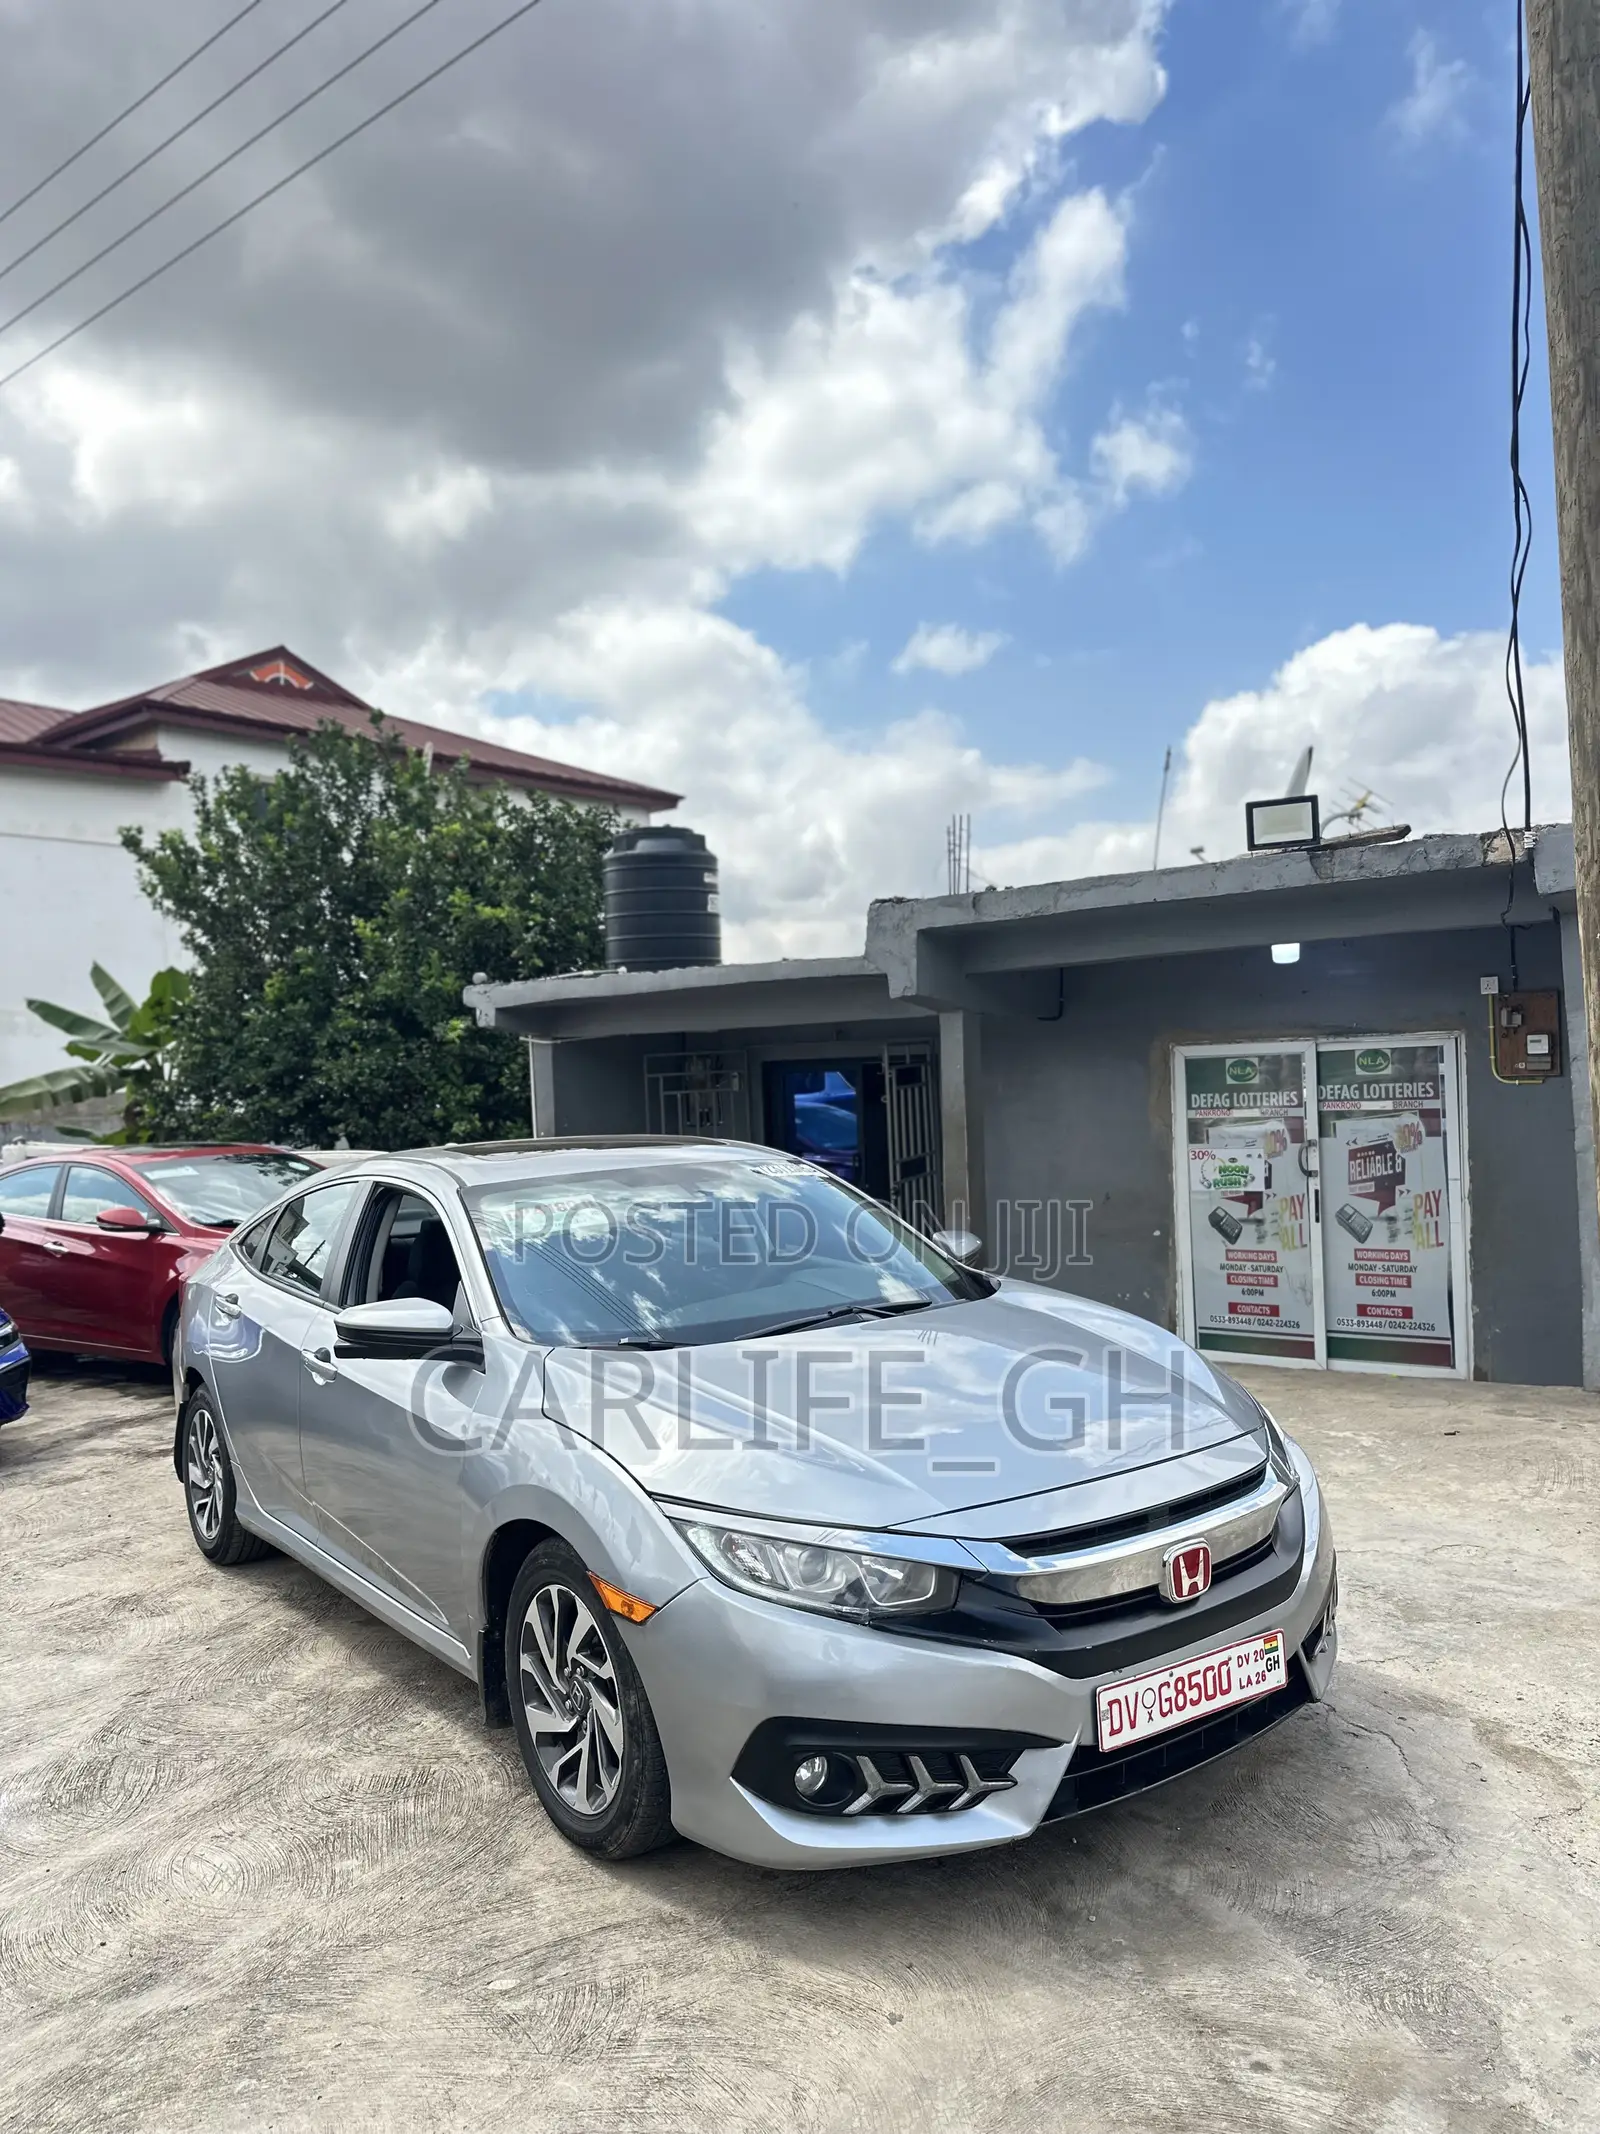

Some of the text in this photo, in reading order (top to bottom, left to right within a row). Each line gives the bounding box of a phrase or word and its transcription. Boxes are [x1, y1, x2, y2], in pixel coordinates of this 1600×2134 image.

[1359, 1056, 1386, 1066] NLA
[1229, 1066, 1254, 1077] NLA
[1318, 1081, 1434, 1100] DEFAG LOTTERIES
[1191, 1091, 1298, 1108] DEFAG LOTTERIES
[1322, 1100, 1424, 1110] PANKRONO BRANCH
[1190, 1149, 1216, 1161] 30%
[1218, 1164, 1250, 1175] NOON
[1349, 1152, 1394, 1182] RELIABLE
[1212, 1177, 1242, 1188] RUSH
[1280, 1193, 1306, 1223] PAY
[1413, 1189, 1442, 1222] PAY
[1227, 1251, 1275, 1261] WORKING DAYS
[1356, 1250, 1408, 1261] WORKING DAYS
[1219, 1263, 1247, 1272] MONDAY
[1250, 1264, 1284, 1273] SATURDAY
[1347, 1263, 1378, 1272] MONDAY
[1382, 1263, 1418, 1273] SATURDAY
[1230, 1275, 1275, 1285] CLOSING TIME
[1359, 1275, 1408, 1286] CLOSING TIME
[1241, 1287, 1264, 1297] 6:00PM
[1371, 1289, 1397, 1298] 6:00PM
[1236, 1304, 1271, 1315] CONTACTS
[1366, 1306, 1403, 1317] CONTACTS
[1236, 1648, 1265, 1668] DV 20
[1265, 1654, 1281, 1673] GH
[1238, 1674, 1253, 1690] LA
[1107, 1690, 1139, 1737] DV
[1157, 1659, 1232, 1718] G8500
